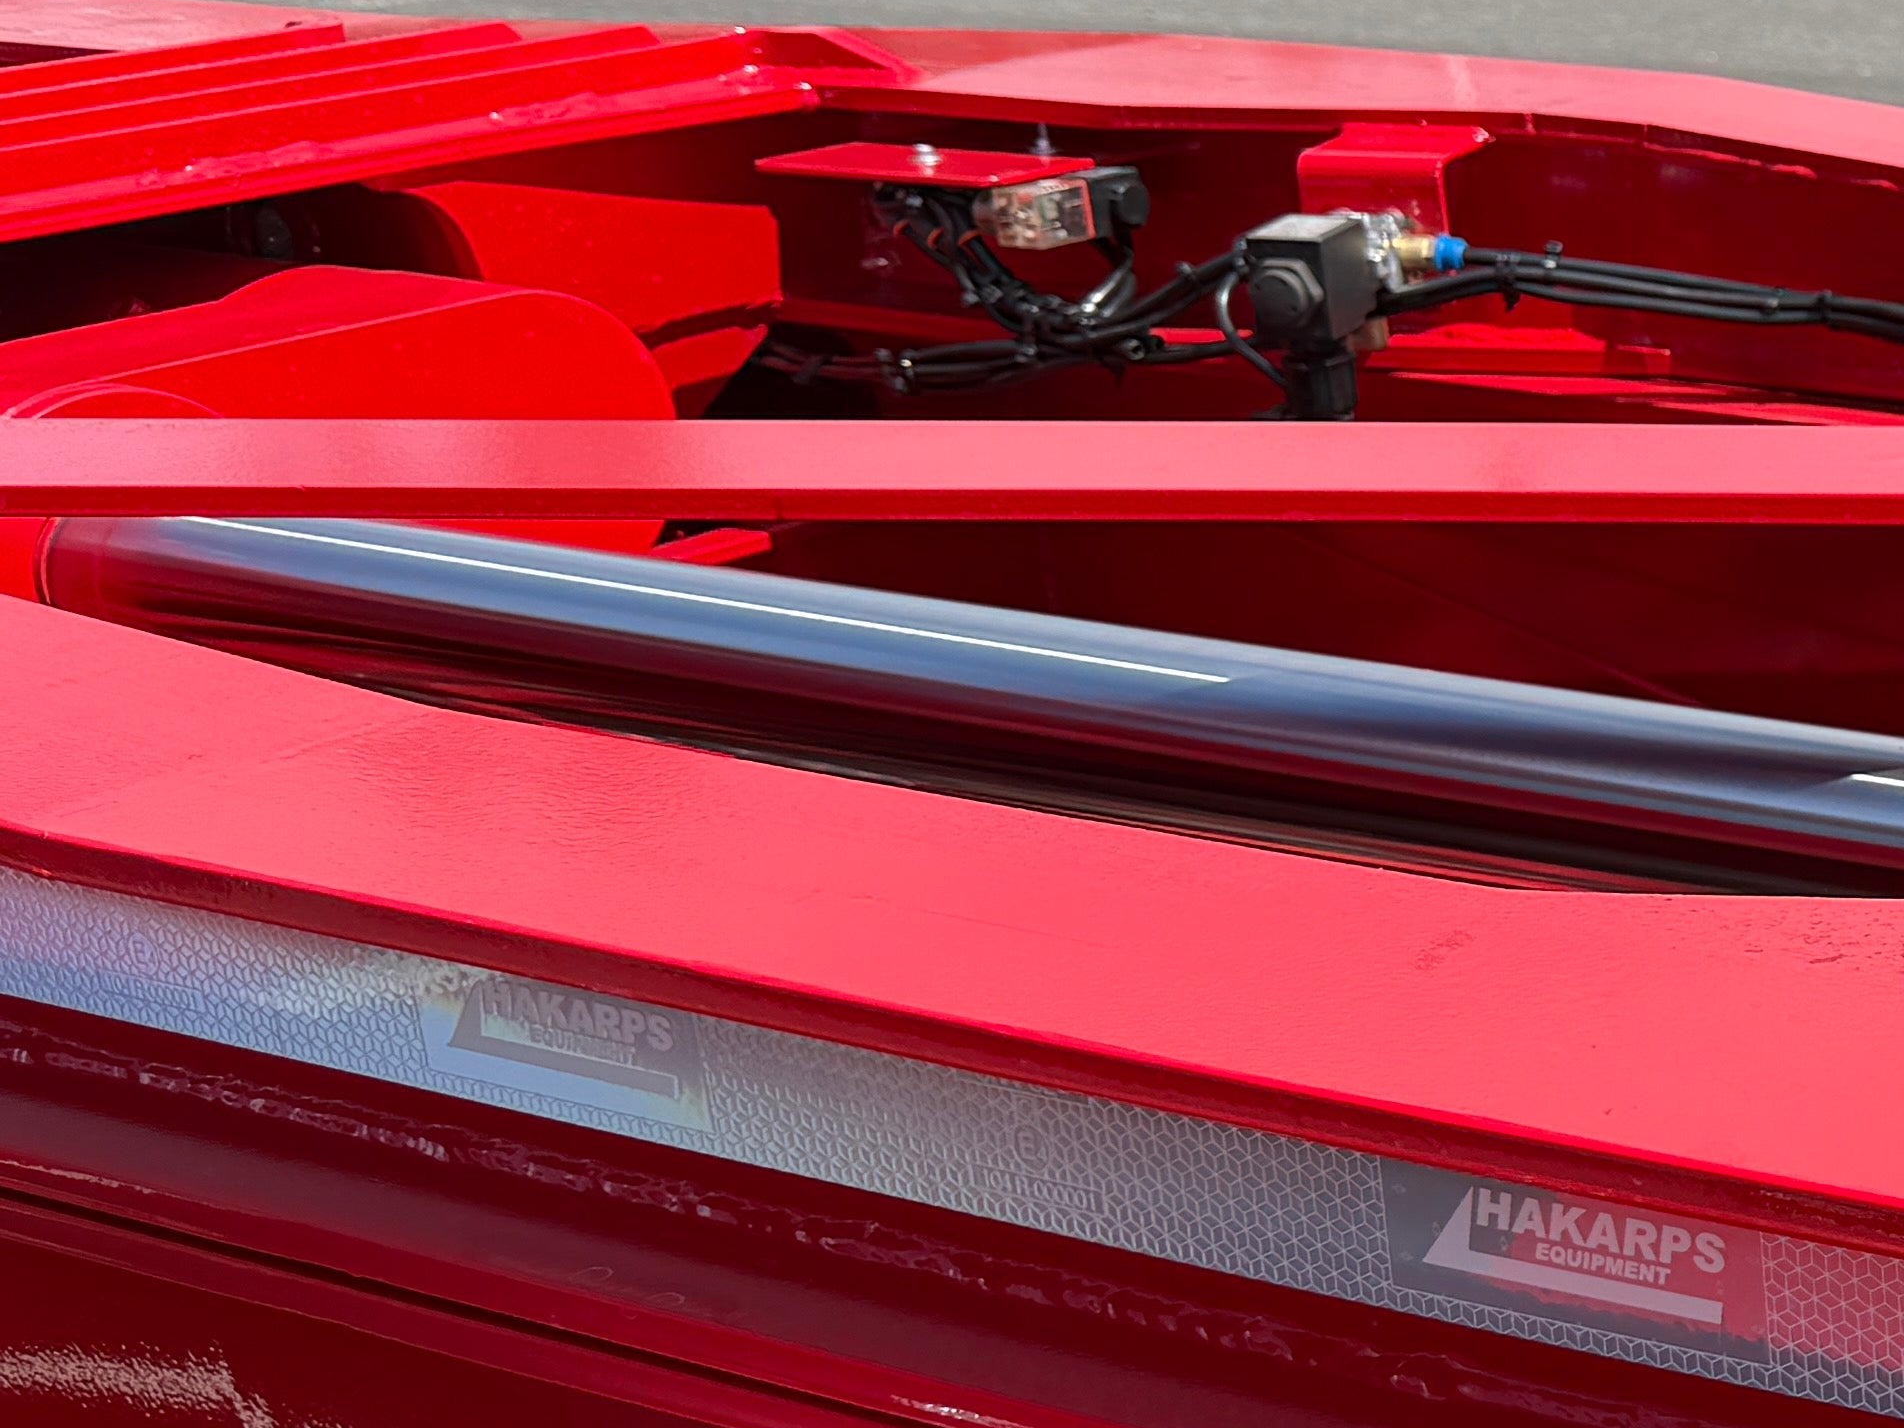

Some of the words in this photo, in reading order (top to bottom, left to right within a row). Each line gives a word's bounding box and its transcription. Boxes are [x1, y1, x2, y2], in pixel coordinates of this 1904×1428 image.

[485, 981, 674, 1052] HAKARPS
[1476, 1187, 1727, 1273] HAKARPS
[1535, 1242, 1671, 1285] EQUIPMENT
